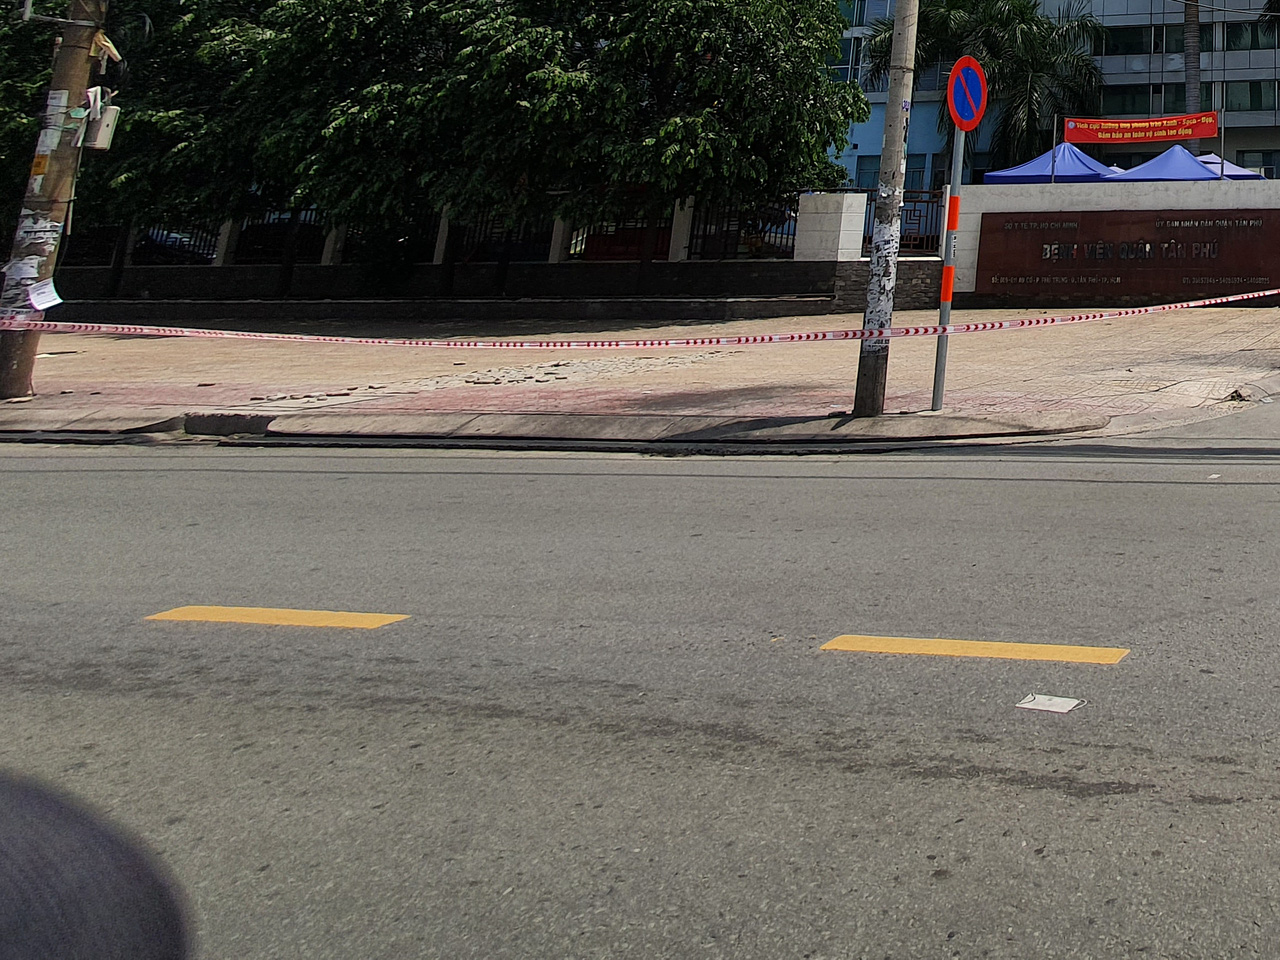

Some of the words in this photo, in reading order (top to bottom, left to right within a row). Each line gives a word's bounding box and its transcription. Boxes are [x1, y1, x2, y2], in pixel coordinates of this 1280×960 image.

[1042, 240, 1078, 262] BỆNH
[1119, 240, 1155, 262] QUẬN
[1160, 239, 1187, 259] TÂN
[1192, 238, 1218, 259] PHÚ
